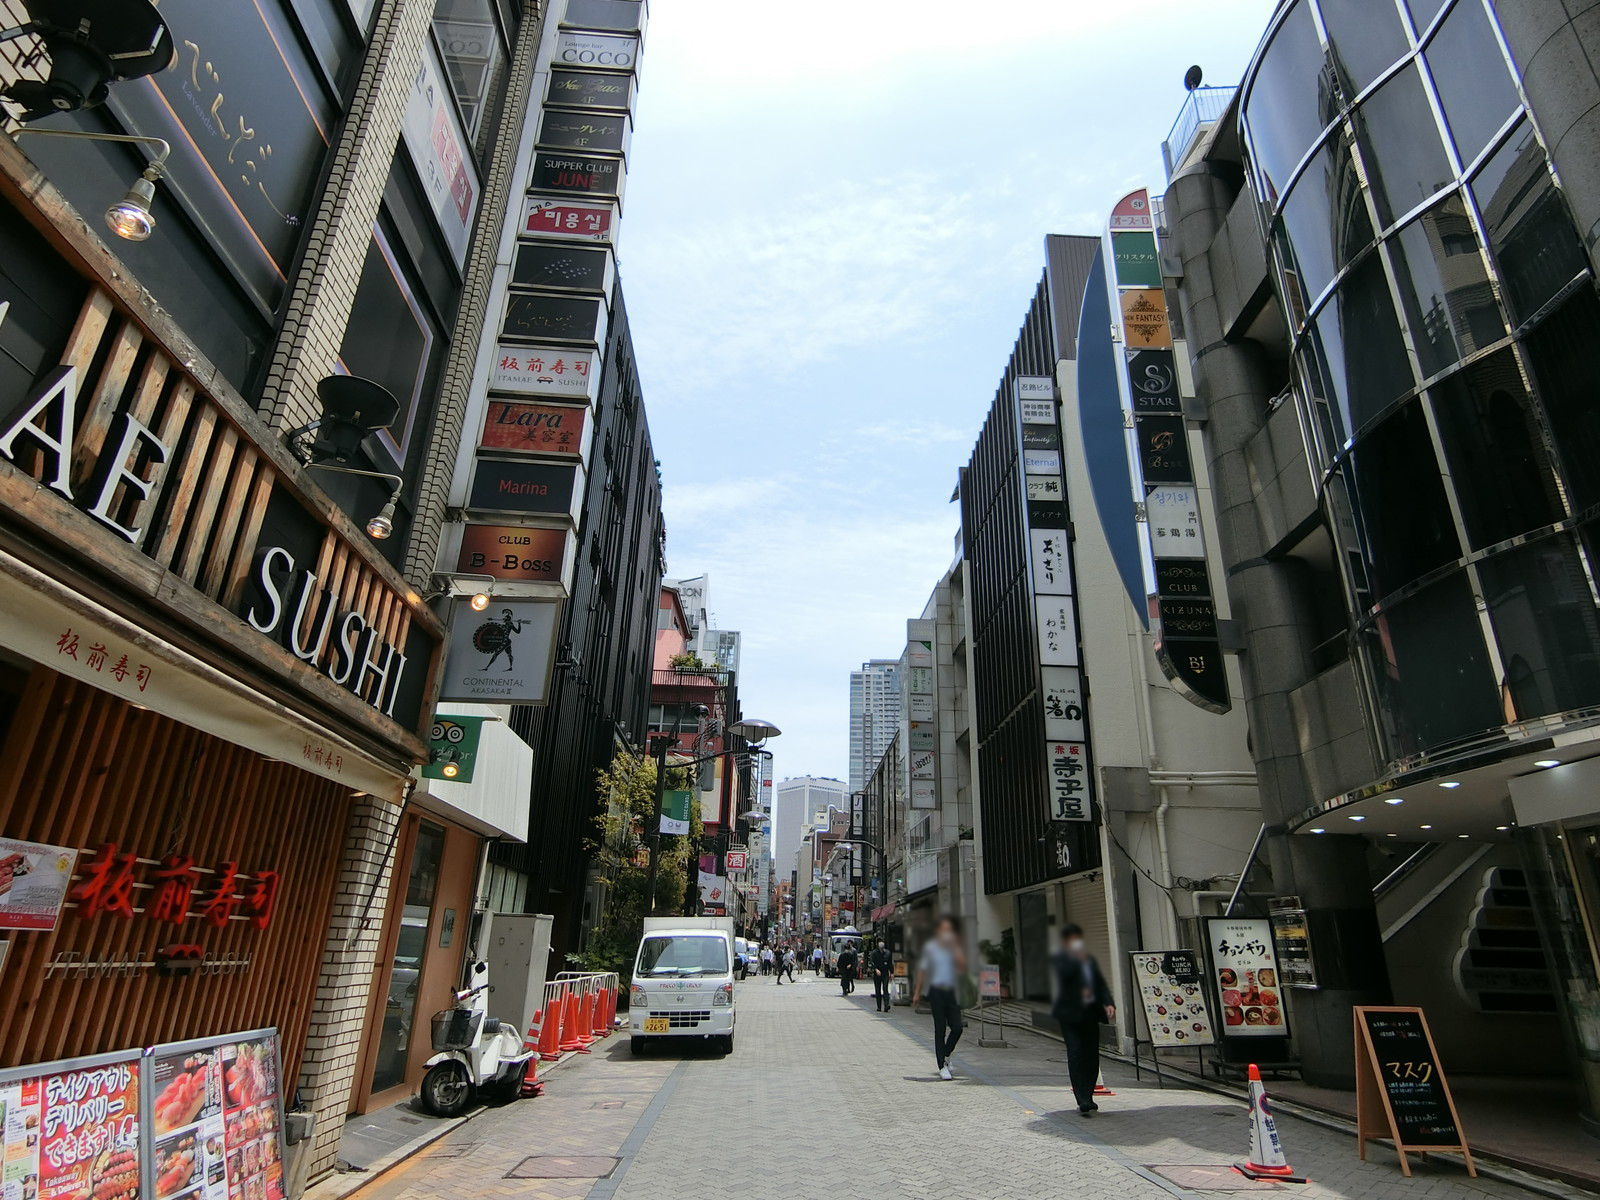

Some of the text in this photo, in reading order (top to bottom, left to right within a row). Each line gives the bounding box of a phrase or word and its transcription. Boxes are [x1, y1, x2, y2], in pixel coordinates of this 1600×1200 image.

[562, 49, 630, 66] COCO
[181, 80, 218, 138] Lavender
[545, 159, 613, 173] SUPPER CLUB
[551, 172, 600, 189] JUNE
[544, 211, 602, 231] 미용실
[1136, 314, 1165, 322] FANTASY
[500, 355, 589, 376] 板前寿司
[498, 375, 586, 387] ITAMAE SUSHI
[1139, 397, 1175, 406] STAR
[496, 405, 563, 428] Lara
[522, 427, 574, 445] 美容室
[1023, 435, 1051, 444] Infinity
[1026, 458, 1058, 467] Eternal
[499, 480, 548, 496] Marina
[1045, 481, 1058, 493] 純
[499, 535, 531, 546] CLUB
[1169, 583, 1198, 592] CLUB
[1163, 606, 1211, 615] KIZUNA
[248, 546, 408, 719] SUSHI
[1046, 619, 1058, 652] わかな
[56, 628, 153, 692] 板前寿司
[463, 677, 524, 687] CONTINENTAL
[303, 742, 344, 774] 板前寿司
[1054, 745, 1080, 755] 赤坂
[1052, 756, 1085, 819] 寺子屋
[729, 855, 743, 867] 酒
[71, 842, 280, 930] 板前寿司
[1218, 939, 1266, 957] チョンギワ
[45, 951, 252, 980] ITAMAE SUSHI
[1386, 1062, 1432, 1083] マスク
[47, 1065, 131, 1106] テイクアウト
[45, 1095, 124, 1137] デリバリー
[45, 1172, 79, 1187] Takeaway
[58, 1180, 86, 1194] Delivery
